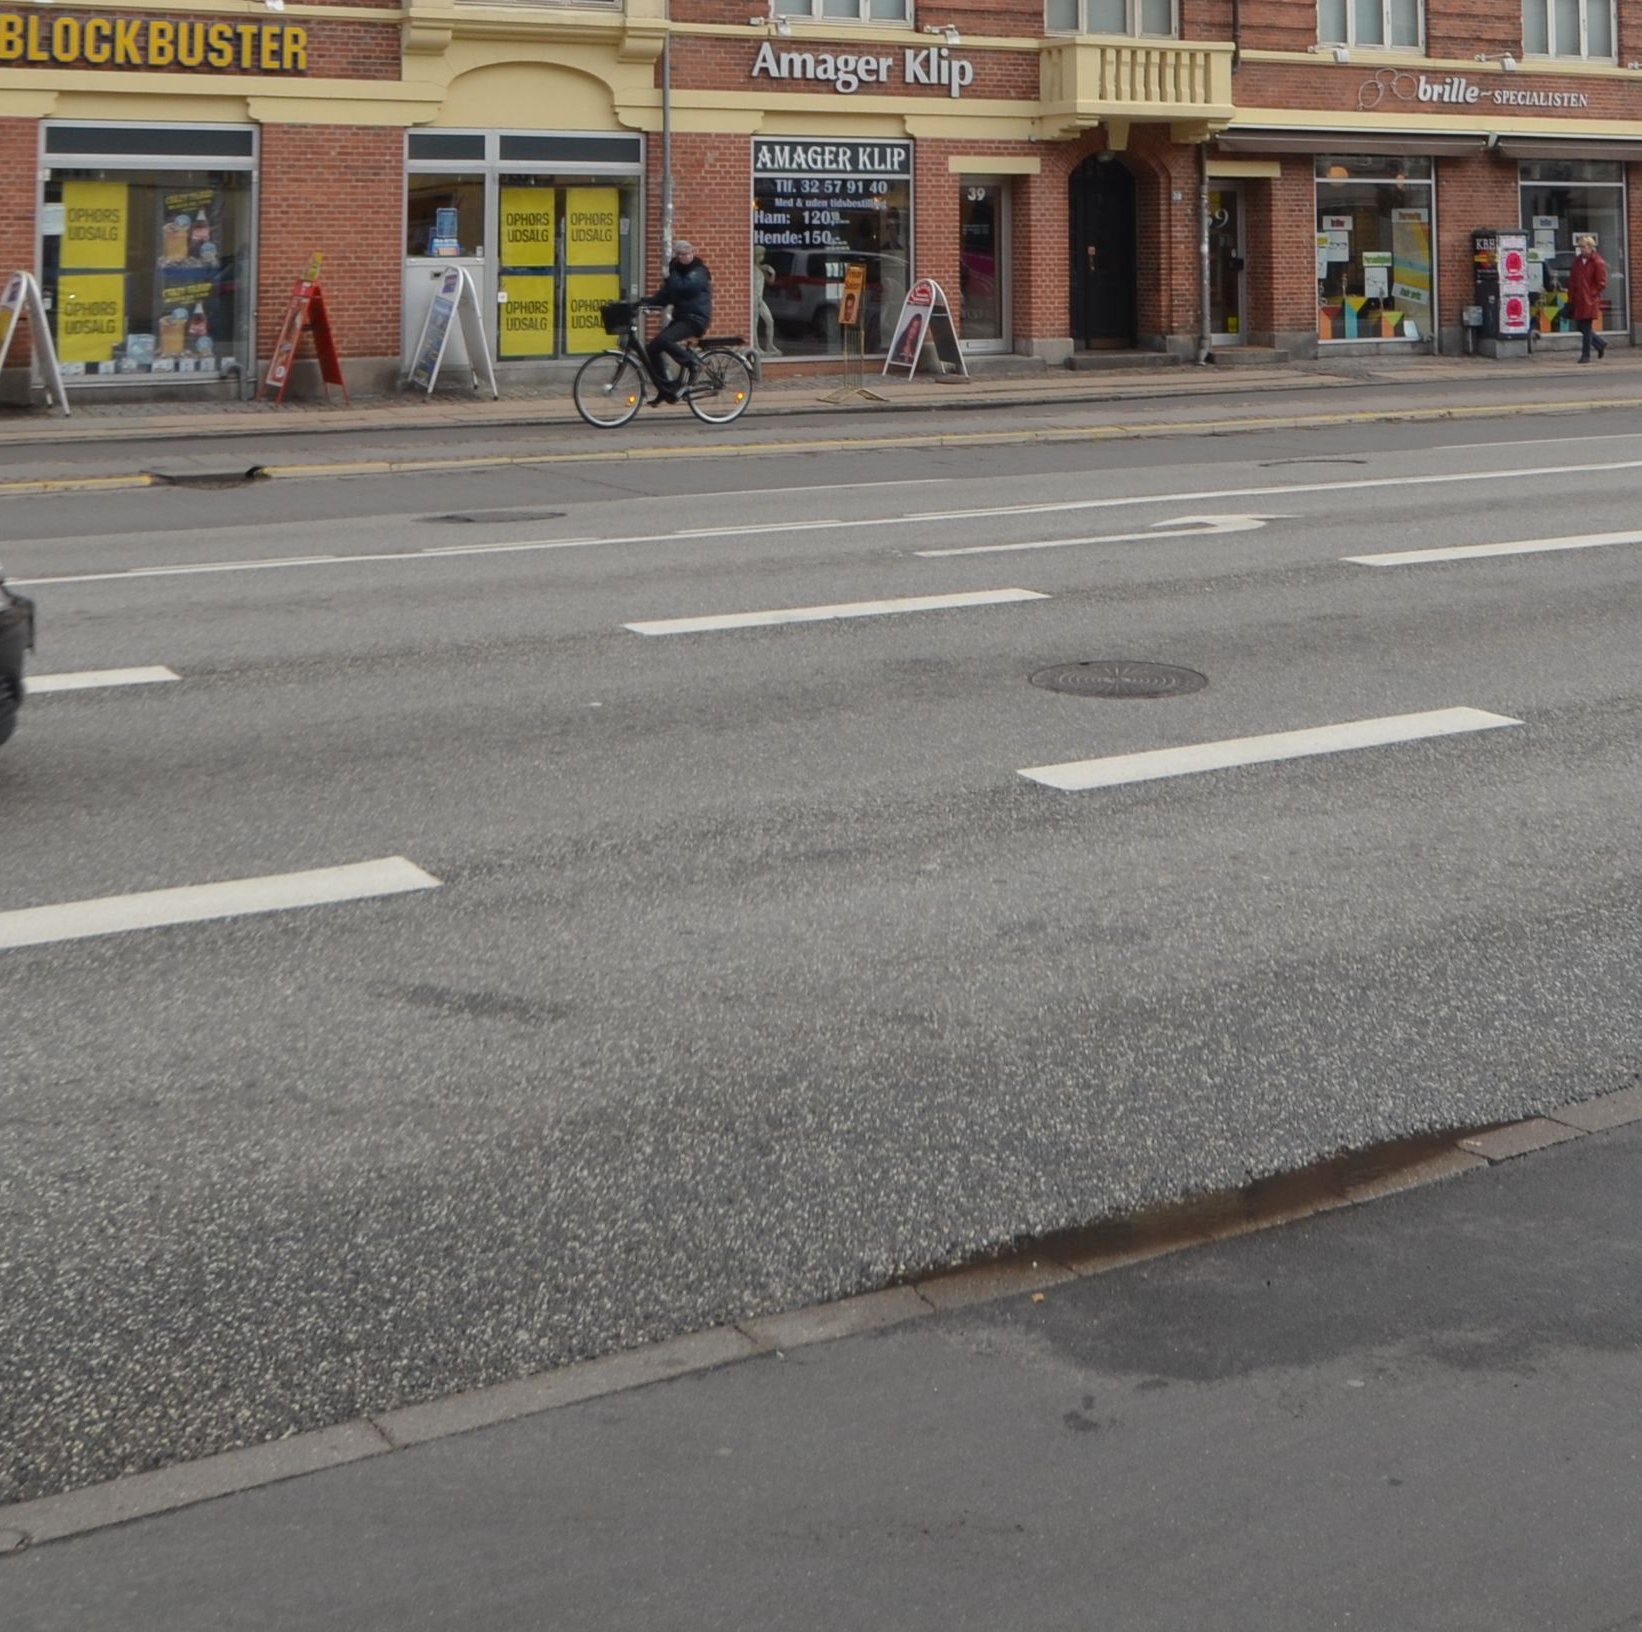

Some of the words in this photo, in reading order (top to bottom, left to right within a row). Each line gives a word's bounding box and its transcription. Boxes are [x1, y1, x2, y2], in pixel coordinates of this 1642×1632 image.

[751, 41, 893, 94] Amager
[904, 46, 974, 98] Klip
[1417, 75, 1479, 104] brille
[1492, 90, 1589, 108] SPECIALISTEN
[757, 145, 853, 172] AMAGER
[858, 147, 906, 171] KLIP
[775, 179, 797, 193] Tlf.
[801, 180, 819, 193] 32
[824, 180, 842, 193] 57
[847, 181, 863, 194] 91
[869, 181, 888, 194] 40
[967, 187, 986, 201] 39
[775, 198, 794, 207] Med
[796, 198, 803, 207] &
[806, 198, 828, 208] uden
[67, 208, 120, 224] OPHØRS
[506, 212, 550, 227] OPHØRS
[570, 212, 614, 226] OPHØRS
[754, 211, 791, 224] Ham:
[68, 226, 119, 241] UDSALG
[507, 229, 549, 243] UDSALG
[571, 228, 613, 242] UDSALG
[754, 230, 803, 244] Hende:
[64, 301, 118, 317] OPHØRS
[505, 300, 549, 314] OPHØRS
[65, 319, 116, 335] UDSALG
[506, 317, 548, 331] UDSALG
[571, 315, 605, 329] UDSAL
